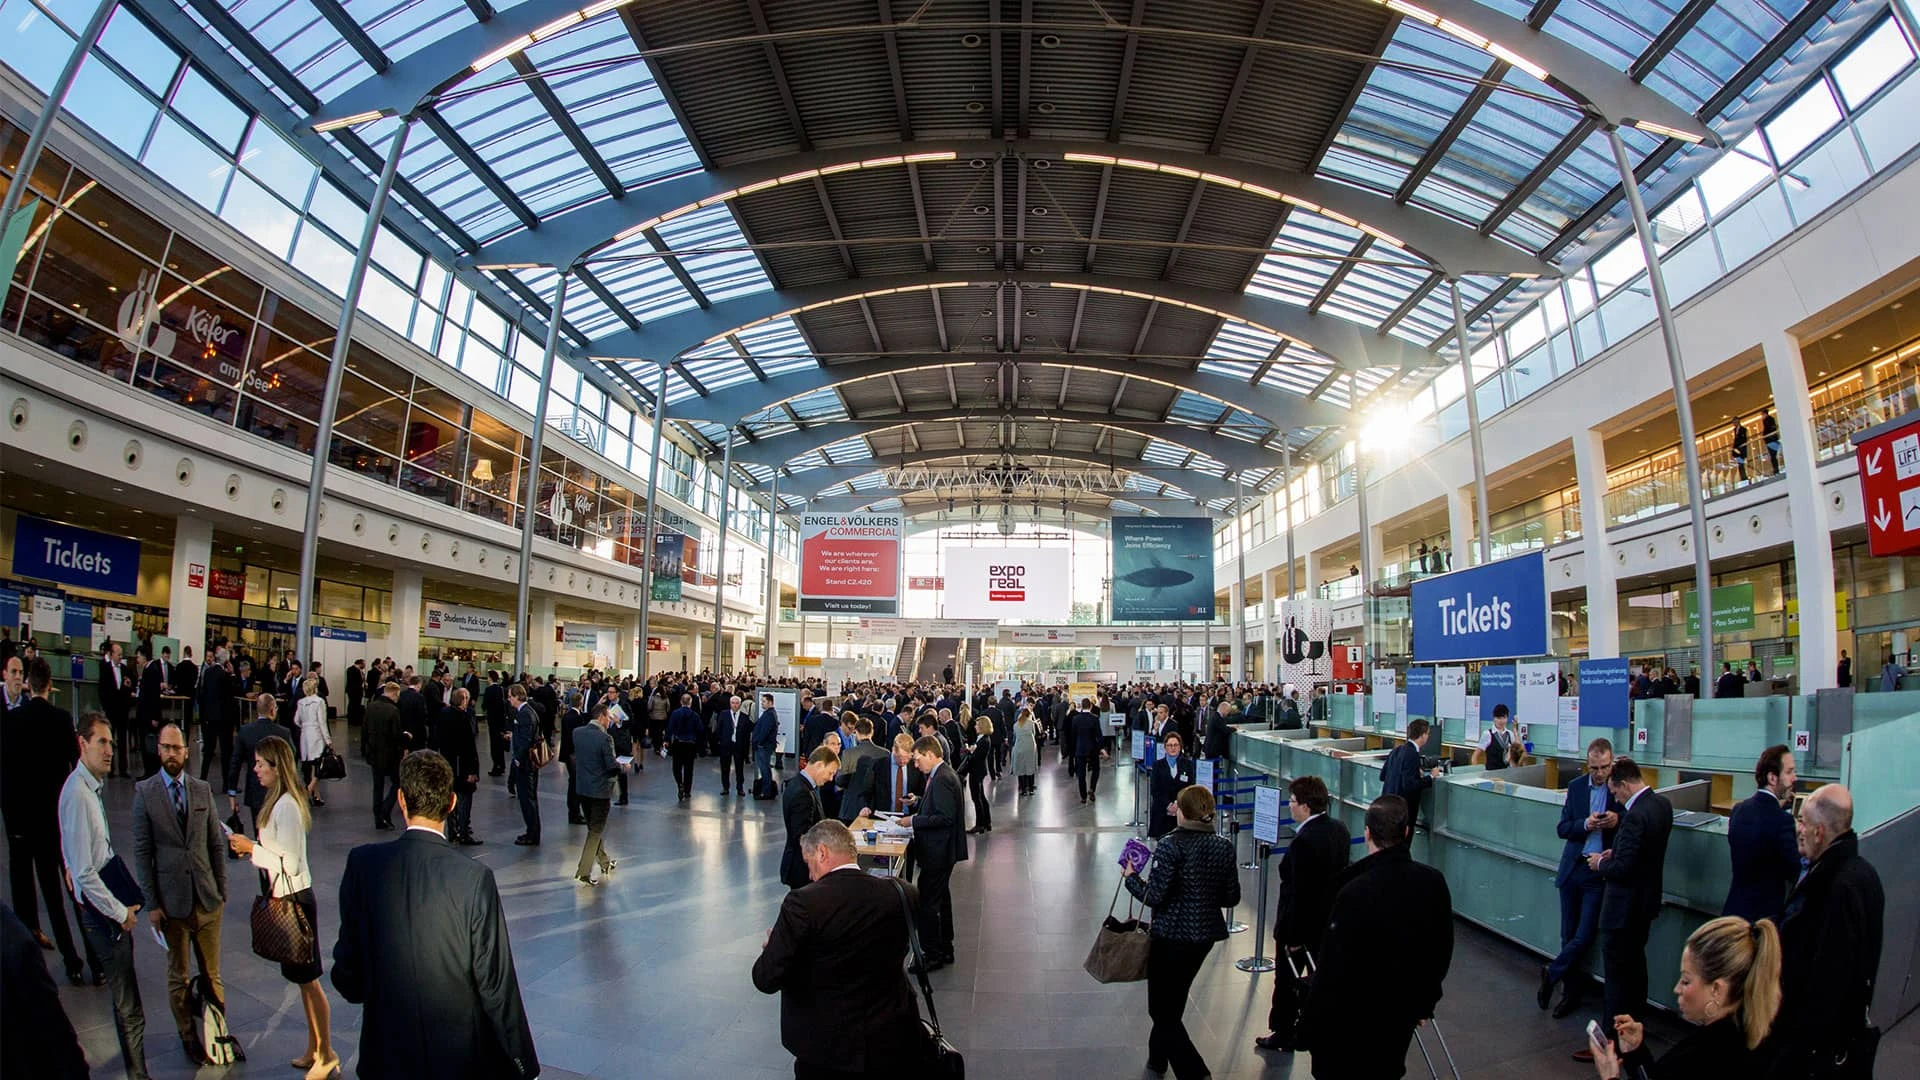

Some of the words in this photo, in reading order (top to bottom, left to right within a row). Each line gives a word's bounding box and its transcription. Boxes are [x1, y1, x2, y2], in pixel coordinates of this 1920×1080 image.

[185, 305, 239, 347] Käfer
[219, 362, 240, 380] am
[247, 369, 269, 393] See
[1898, 447, 1917, 466] LIFT
[830, 527, 898, 537] COMMERCIAL
[1142, 542, 1172, 550] Efficiency
[43, 537, 112, 575] Tickets
[844, 565, 860, 573] right
[989, 565, 1025, 579] expo
[443, 613, 467, 624] Students
[467, 616, 487, 628] Pick-Up
[487, 618, 507, 628] Counter
[1438, 592, 1512, 636] Tickets
